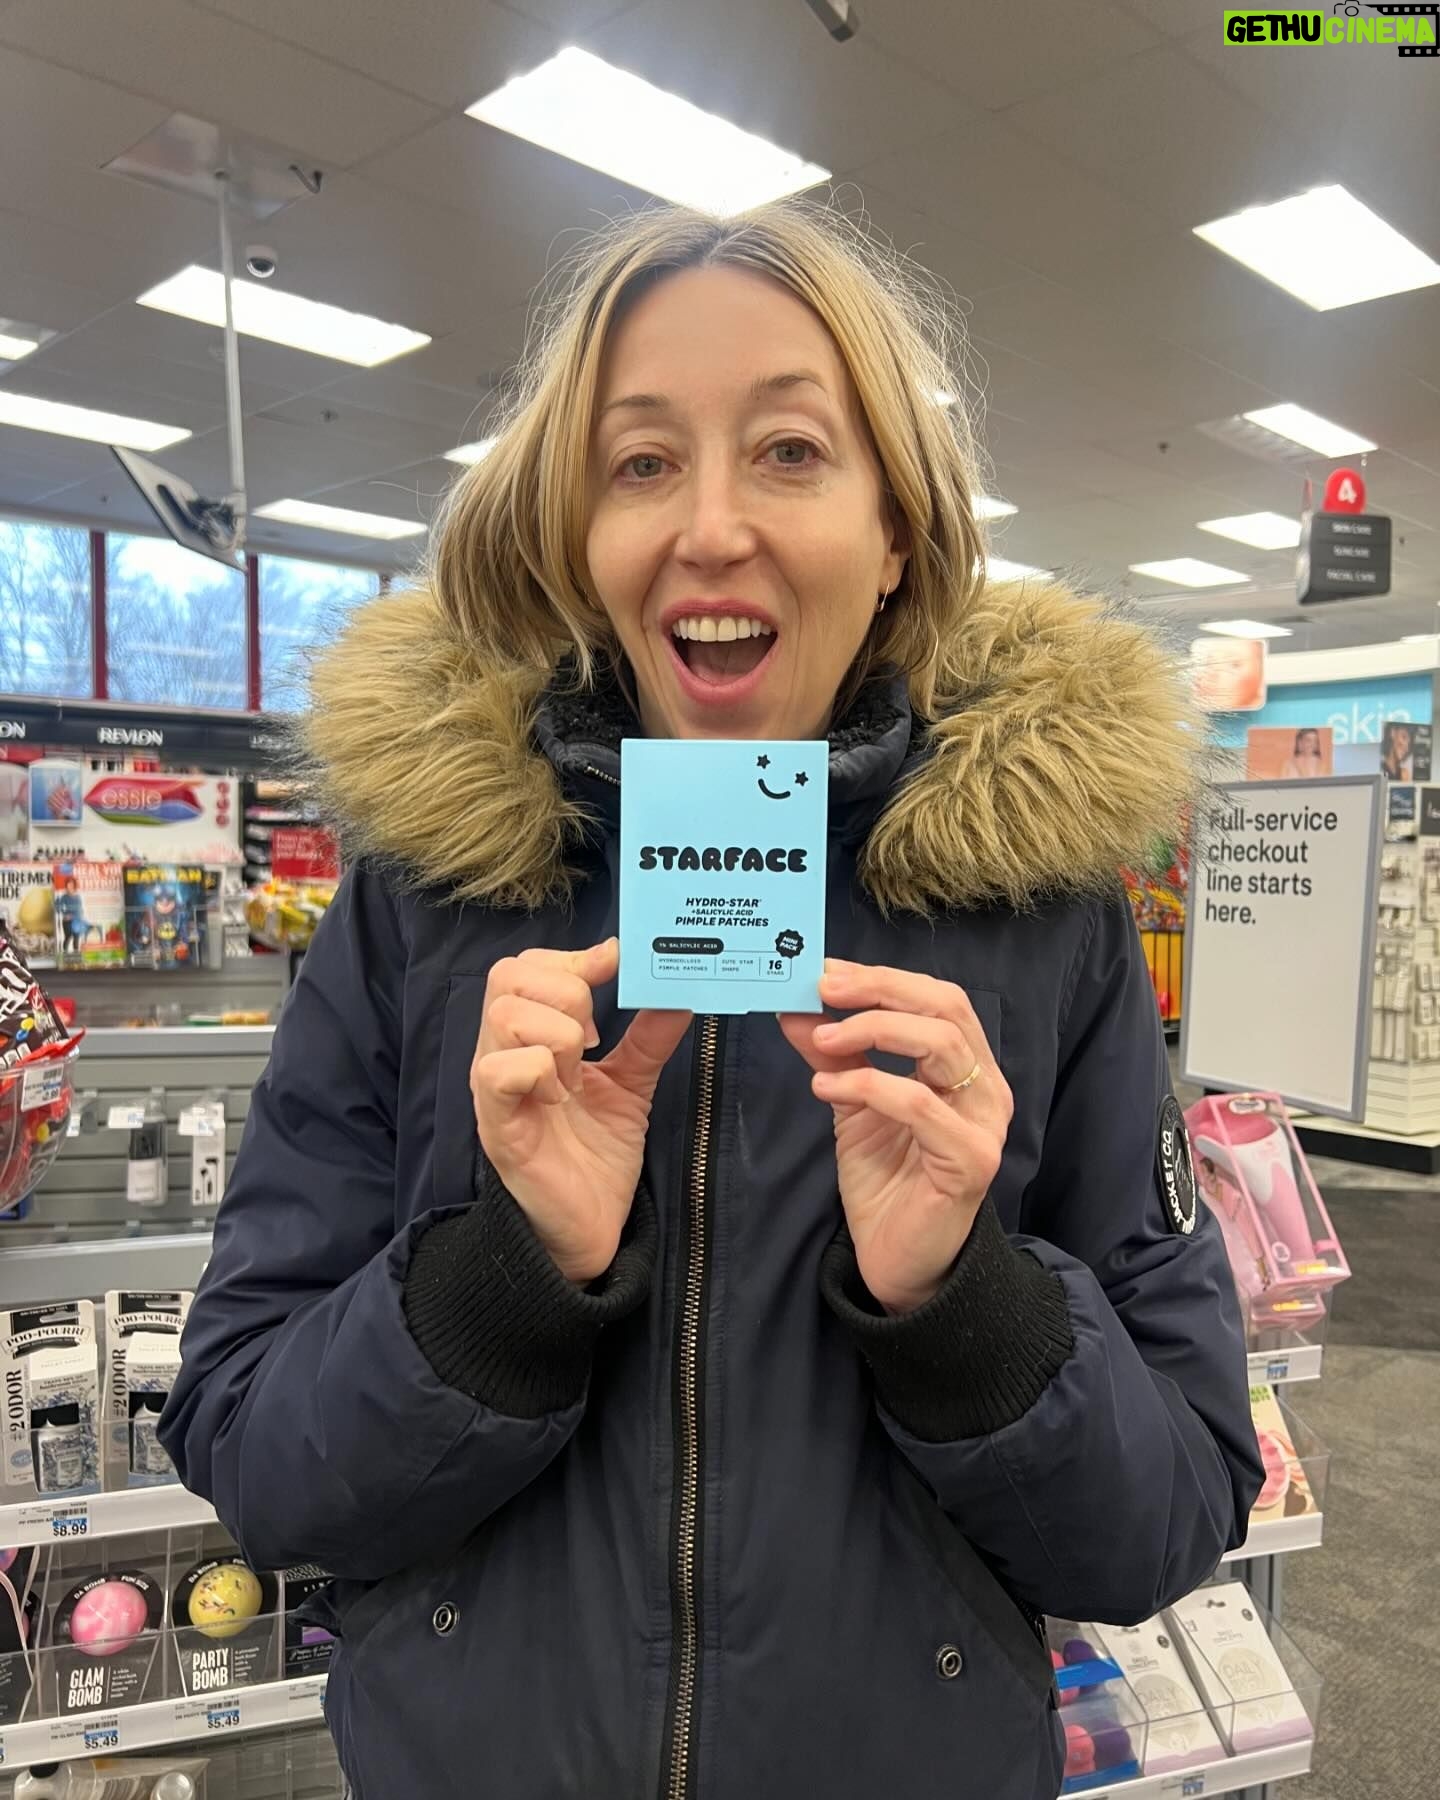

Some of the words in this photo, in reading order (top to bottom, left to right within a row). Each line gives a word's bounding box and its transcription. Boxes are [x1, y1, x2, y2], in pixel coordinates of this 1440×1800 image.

[1337, 477, 1357, 504] 4
[98, 727, 163, 746] REVLON
[102, 788, 162, 811] essie
[639, 846, 808, 872] STARFACE
[1208, 837, 1308, 863] checkout
[1206, 867, 1243, 892] line
[1247, 872, 1312, 896] starts
[686, 897, 759, 908] HYDRO-STAR
[1205, 898, 1256, 924] here.
[675, 917, 716, 926] PIMPLE
[718, 917, 769, 927] PATCHES
[768, 960, 782, 970] 16
[112, 1349, 126, 1396] ODOR
[6, 1370, 24, 1419] ODOR
[53, 1524, 87, 1537] $8.99
[192, 1648, 229, 1670] PARTY
[70, 1666, 104, 1689] GLAM
[192, 1667, 229, 1691] BOMB
[67, 1686, 103, 1708] BOMB
[207, 1715, 240, 1728] $5.49
[85, 1735, 118, 1749] $5.49
